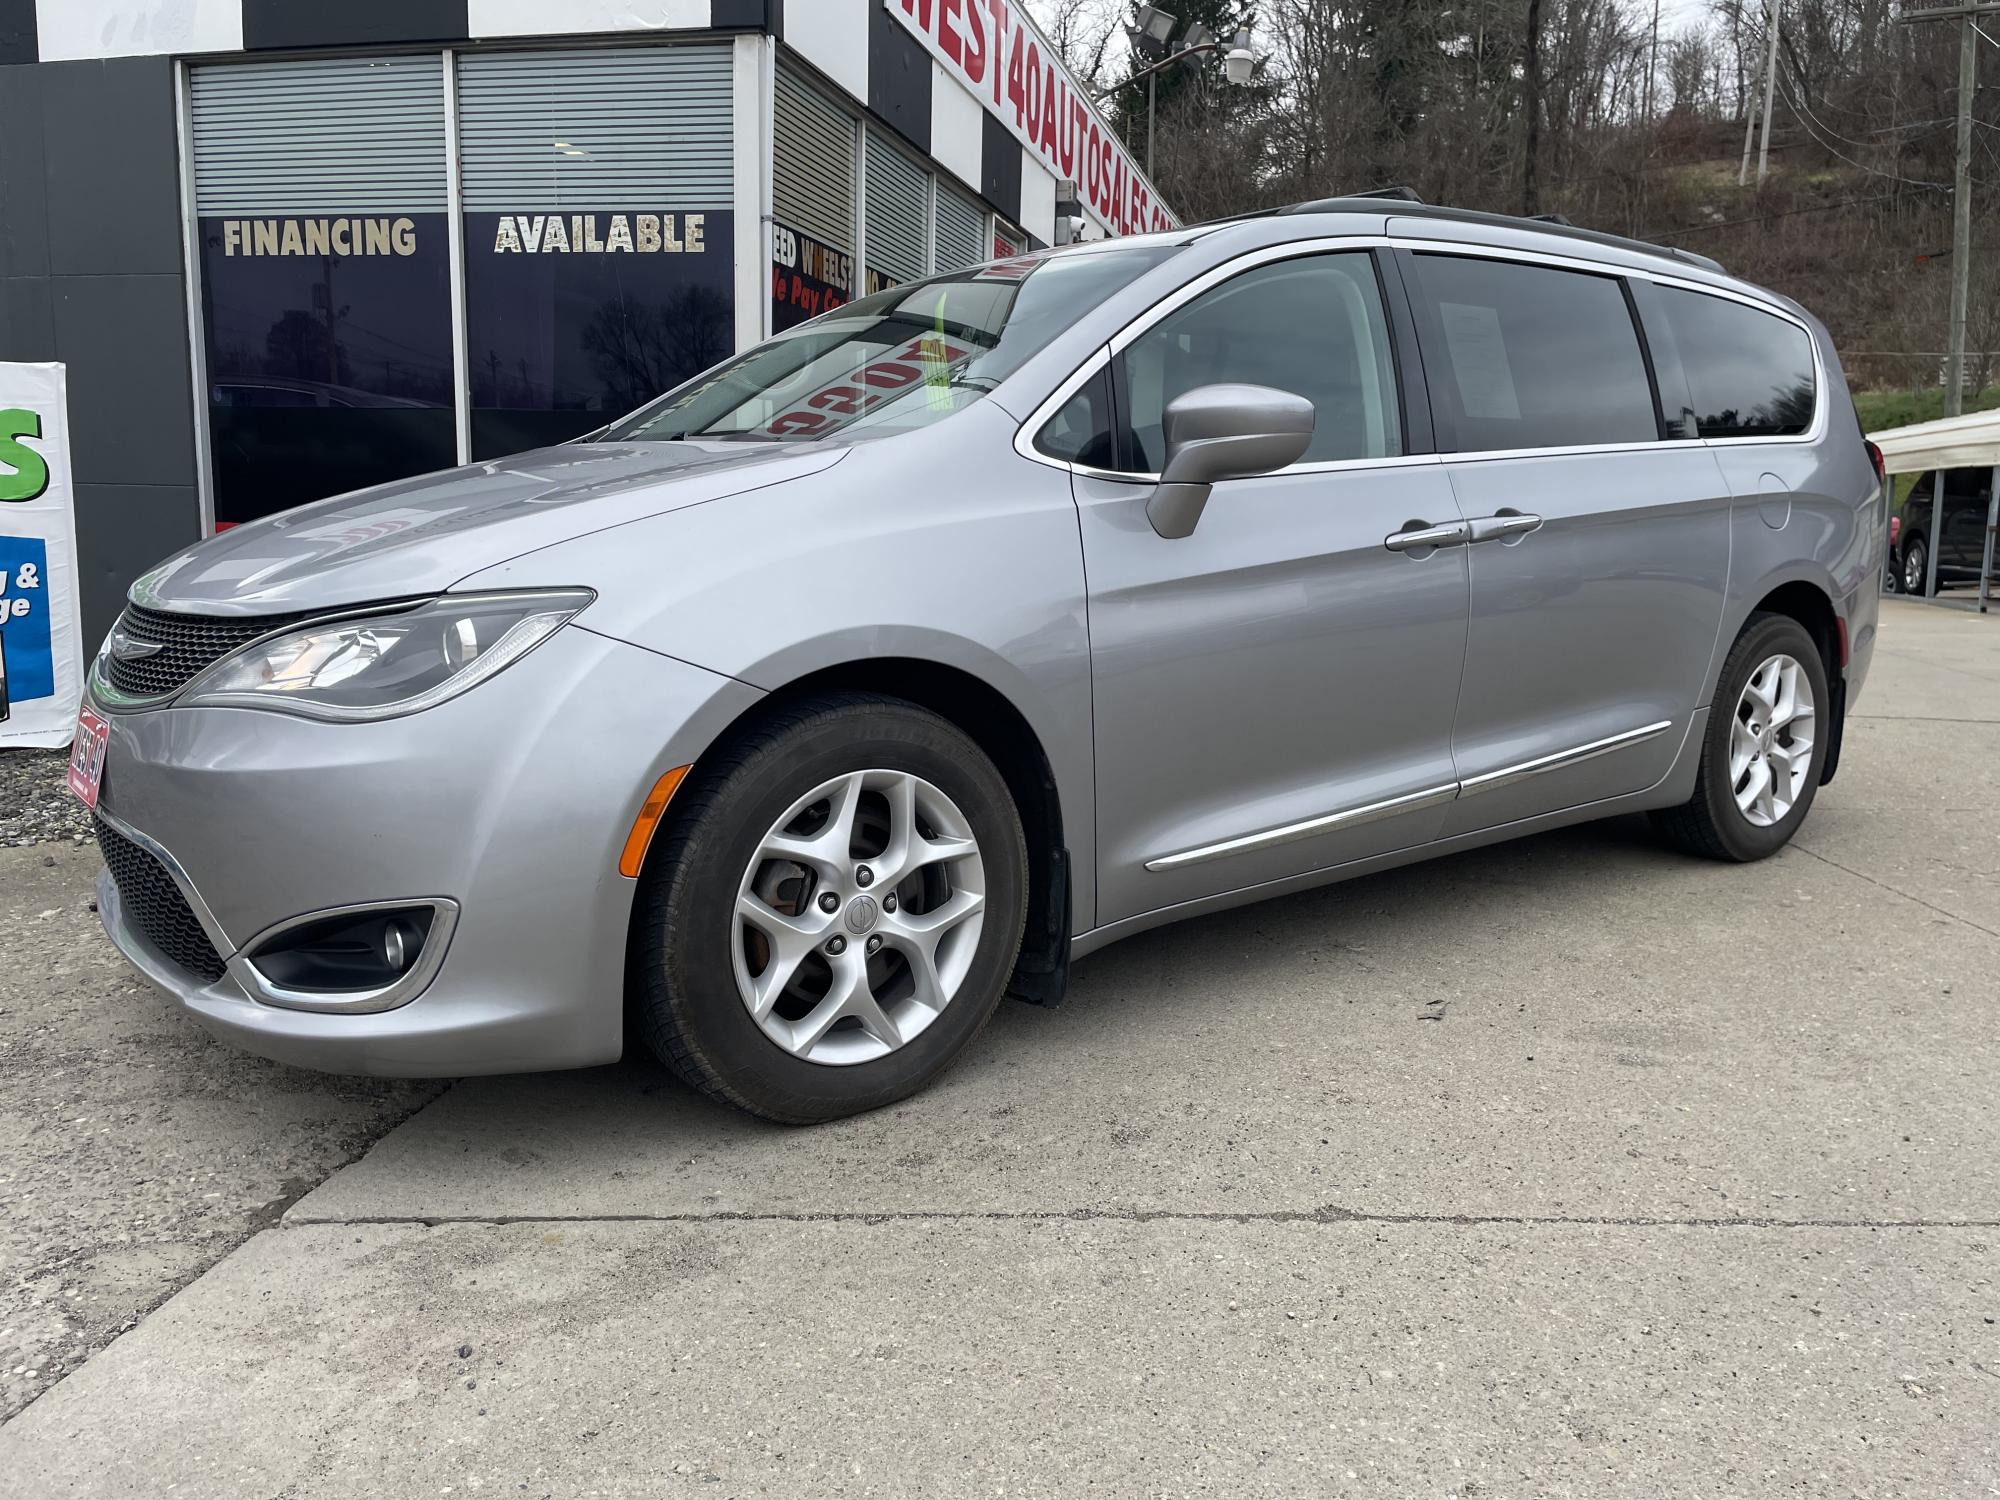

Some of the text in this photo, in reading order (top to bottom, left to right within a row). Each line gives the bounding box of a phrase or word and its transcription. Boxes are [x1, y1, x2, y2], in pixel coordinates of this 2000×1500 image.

[223, 214, 705, 257] FINANCING AVAILABLE
[772, 223, 797, 269] EED
[791, 274, 820, 317] Pay
[16, 562, 40, 588] &
